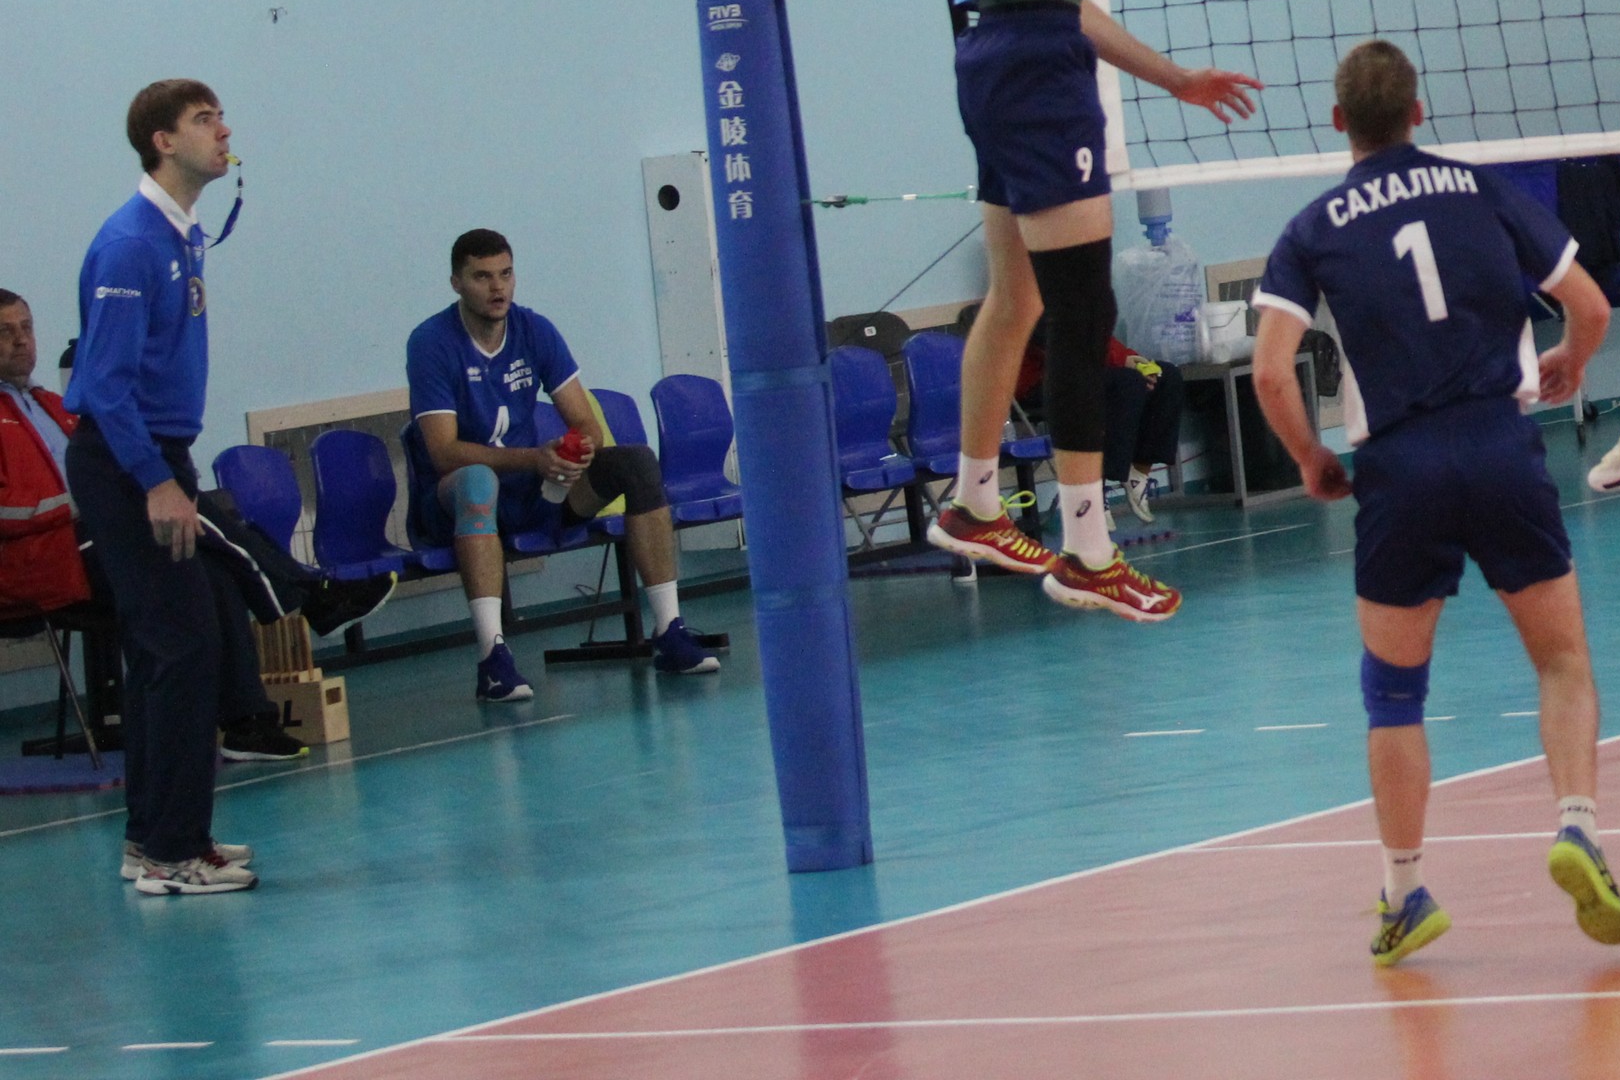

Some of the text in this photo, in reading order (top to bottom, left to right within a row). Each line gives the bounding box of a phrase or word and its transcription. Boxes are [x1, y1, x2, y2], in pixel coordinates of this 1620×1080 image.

[717, 80, 754, 220] 金陵体育
[1075, 146, 1093, 183] 9
[1326, 166, 1479, 228] САХАЛИН
[1392, 220, 1449, 322] 1
